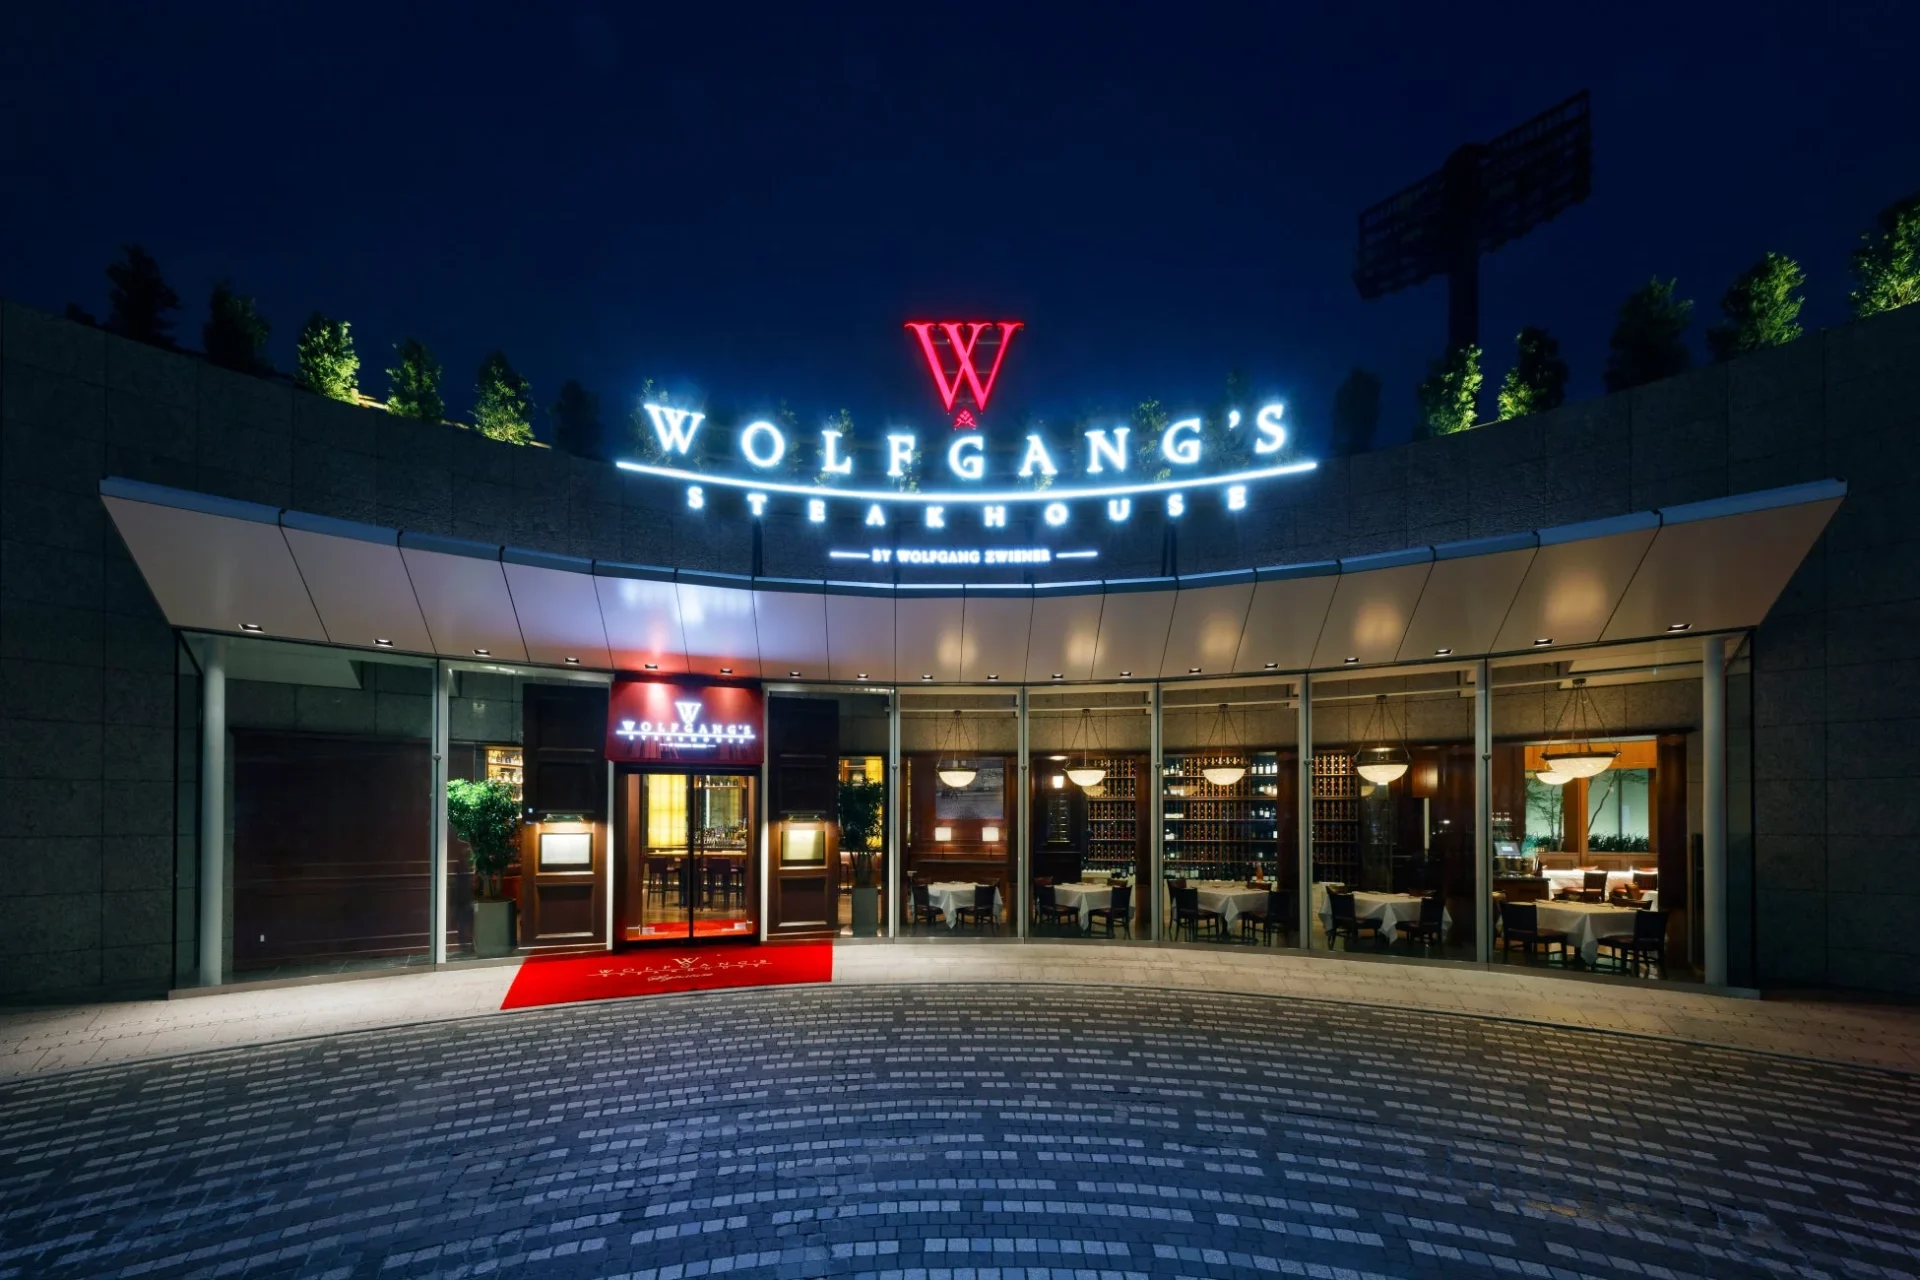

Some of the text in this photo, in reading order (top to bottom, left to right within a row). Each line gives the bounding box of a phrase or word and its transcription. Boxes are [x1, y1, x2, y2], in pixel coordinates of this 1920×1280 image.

[904, 322, 1024, 412] W
[643, 402, 1285, 480] WOLFGANG'S
[686, 485, 1248, 528] STEAKHOUSE
[872, 549, 891, 562] BY
[897, 550, 980, 563] WOLFGANG
